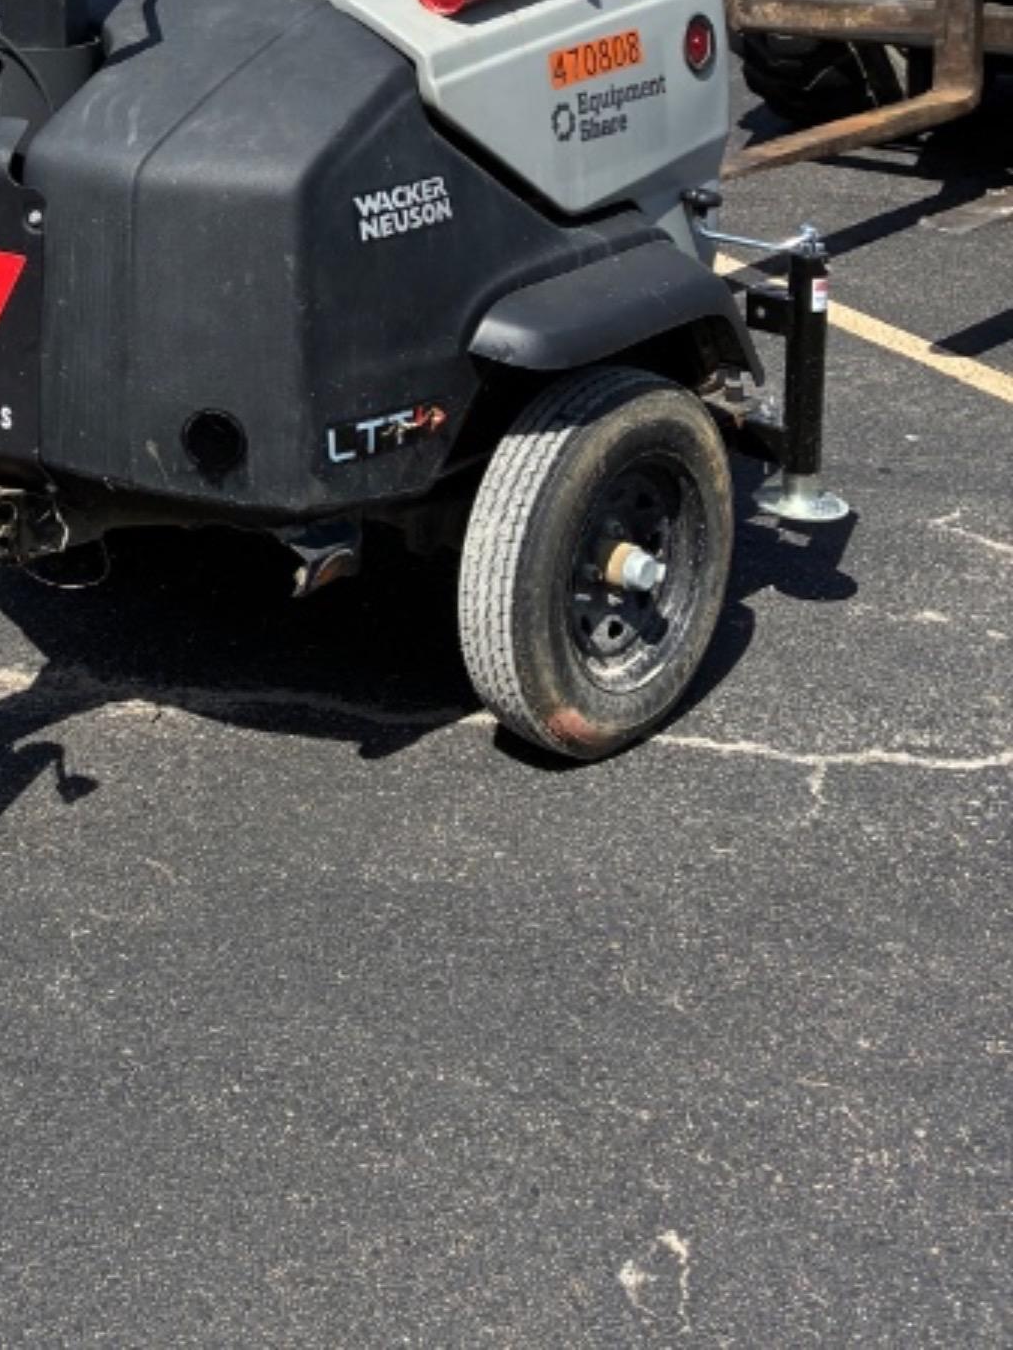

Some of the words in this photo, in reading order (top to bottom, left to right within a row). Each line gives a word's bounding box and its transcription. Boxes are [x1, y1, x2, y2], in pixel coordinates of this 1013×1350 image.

[553, 30, 640, 87] 470808
[576, 74, 666, 115] Equipment
[578, 113, 628, 142] Share
[352, 175, 449, 217] WACKER
[359, 196, 453, 242] NEUSON
